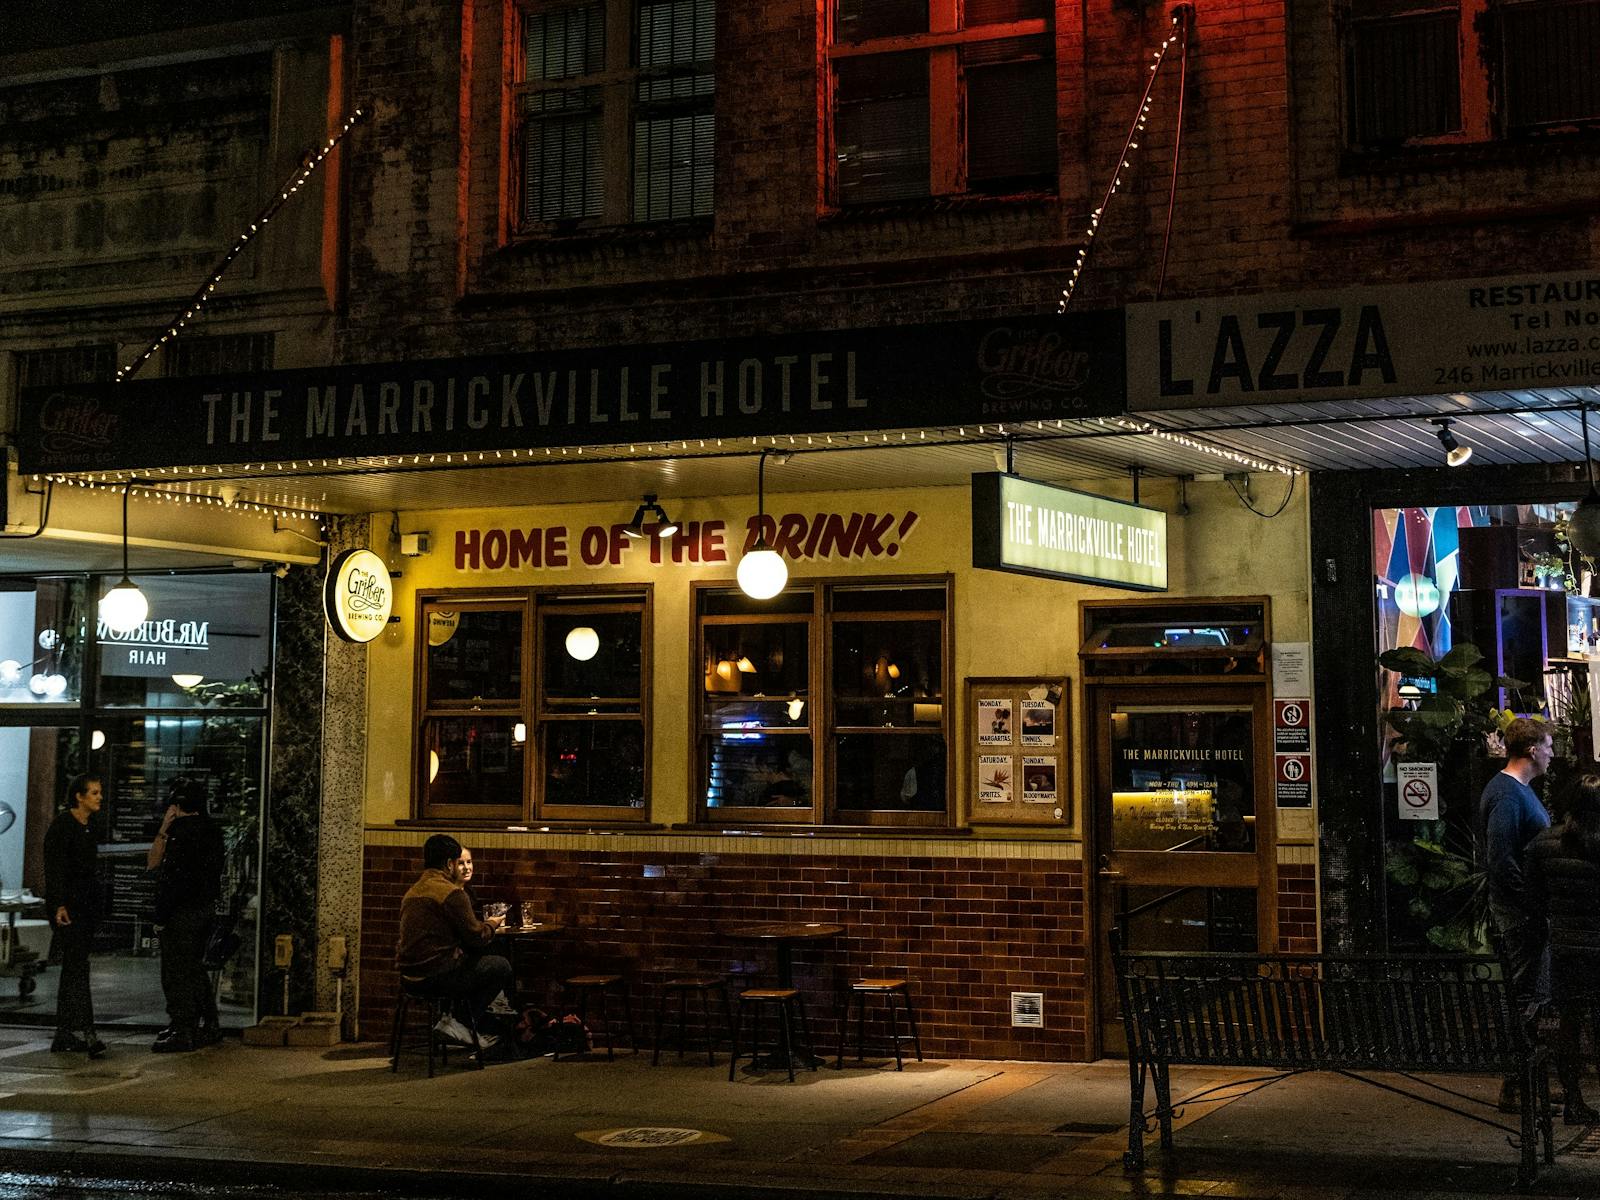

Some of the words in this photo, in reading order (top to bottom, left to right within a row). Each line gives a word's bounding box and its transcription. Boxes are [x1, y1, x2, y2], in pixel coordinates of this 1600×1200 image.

[1469, 280, 1600, 308] RESTAUR
[1510, 311, 1550, 330] Tel
[1565, 309, 1599, 327] No
[1159, 304, 1398, 397] L'AZZA
[1466, 337, 1600, 358] www.lazza.c
[1434, 366, 1473, 385] 246
[1482, 359, 1600, 382] Marrickville
[202, 389, 282, 445] THE
[305, 363, 672, 438] MARRICKVILLE
[701, 351, 868, 418] HOTEL
[982, 400, 1055, 415] BREWING
[454, 526, 568, 570] HOME
[580, 523, 632, 567] OF
[642, 520, 728, 565] THE
[742, 510, 919, 562] DRINK!
[1008, 501, 1033, 546] THE
[1037, 507, 1124, 561] MARRICKVILLE
[1127, 525, 1162, 568] HOTEL
[348, 568, 385, 603] Grifter
[348, 613, 373, 621] BREWING
[1122, 748, 1140, 760] THE
[1144, 749, 1211, 761] MARRICKVILLE
[1215, 749, 1244, 761] HOTEL
